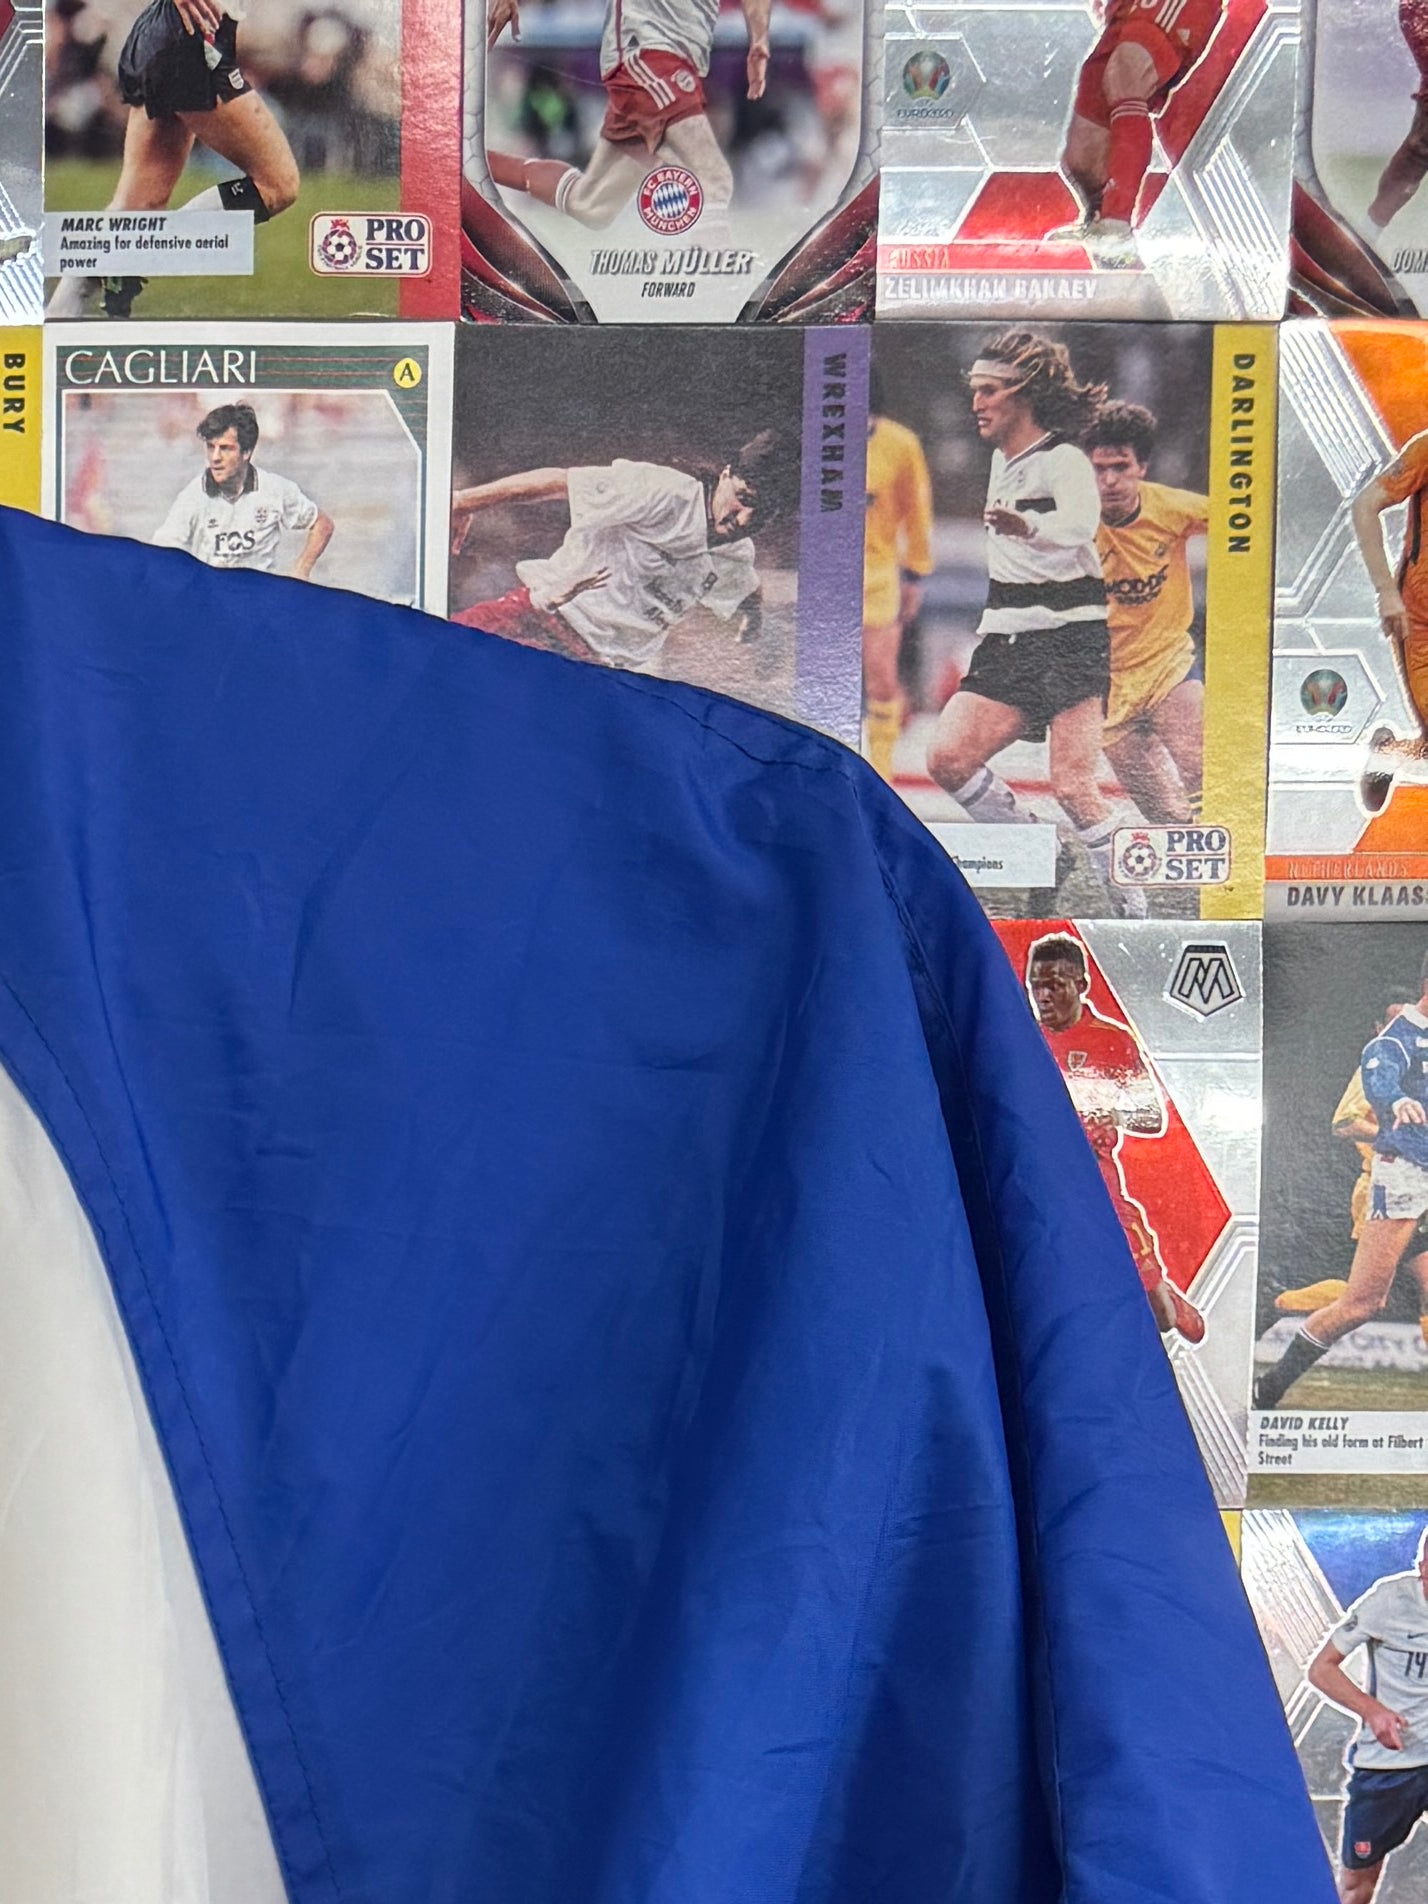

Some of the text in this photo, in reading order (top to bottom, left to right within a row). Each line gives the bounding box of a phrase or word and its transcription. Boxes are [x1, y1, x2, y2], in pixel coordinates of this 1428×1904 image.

[657, 170, 699, 195] BAYERN
[61, 217, 167, 232] MARC WRIGHT
[365, 219, 425, 242] PRO
[60, 234, 229, 252] Amazing for defensive aerial
[60, 257, 97, 272] power
[365, 248, 425, 270] SET
[591, 245, 753, 275] THOMAS MÜLLER
[641, 282, 695, 297] FORWARD
[1014, 277, 1098, 299] BAKAEV
[64, 350, 256, 385] CAGLIARI
[399, 363, 415, 384] A
[3, 353, 26, 434] BURY
[820, 352, 847, 513] WREXHAM
[1228, 353, 1256, 554] DARLINGTON
[1166, 830, 1226, 852] PRO
[1166, 858, 1225, 881] SET
[1287, 886, 1344, 906] DAVY
[1260, 1417, 1349, 1431] DAVID KELLY
[1259, 1435, 1424, 1451] Finding his old form at Filbert
[1258, 1452, 1293, 1465] Street
